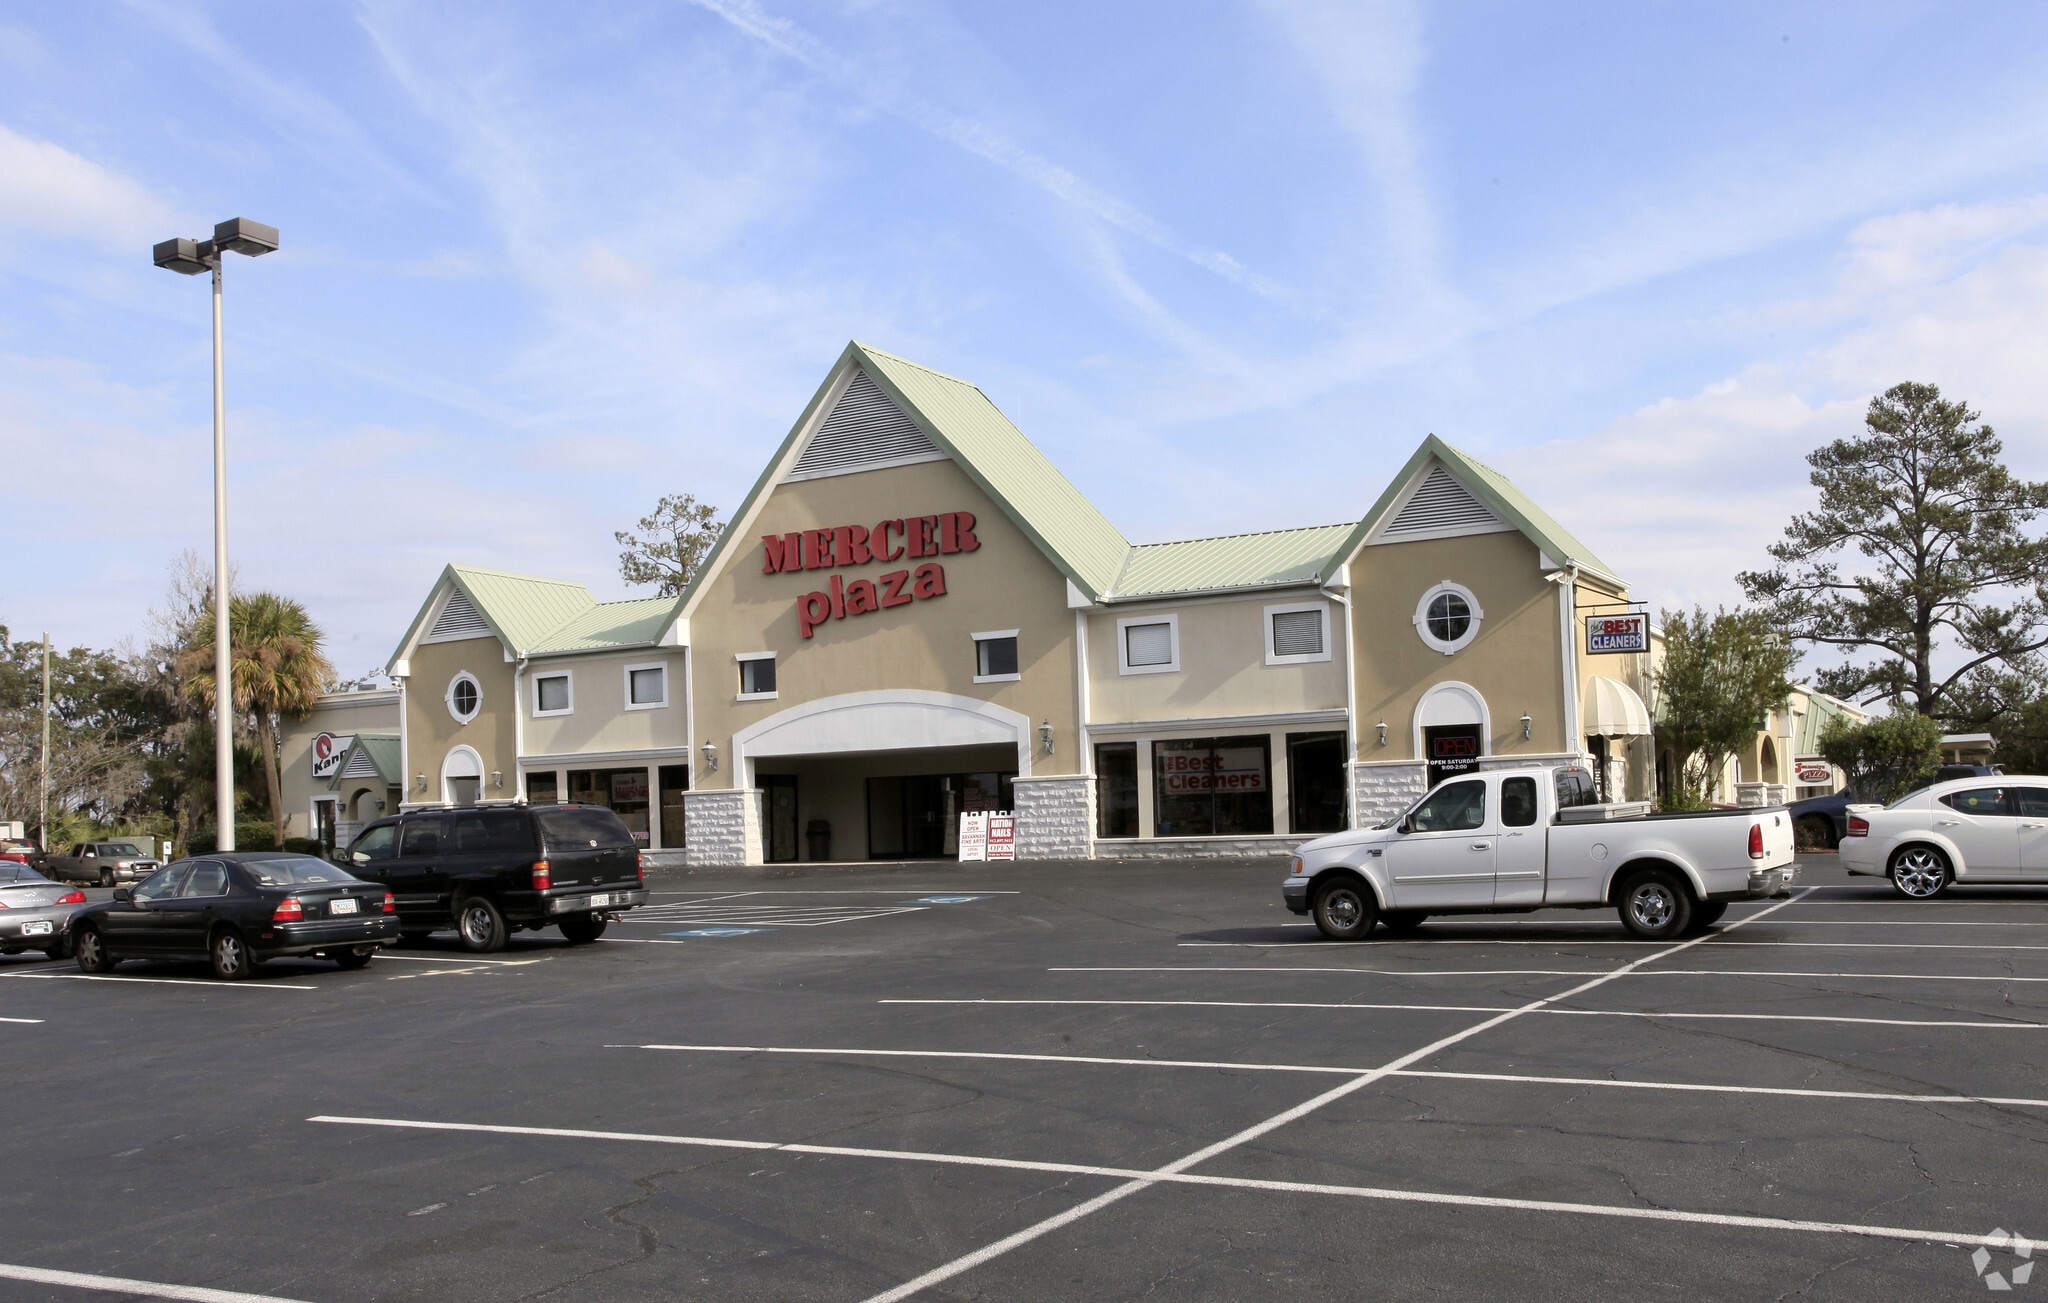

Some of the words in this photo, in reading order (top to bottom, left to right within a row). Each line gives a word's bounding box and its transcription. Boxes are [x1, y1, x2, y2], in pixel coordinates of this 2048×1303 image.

[761, 511, 982, 574] MERCER
[796, 562, 948, 639] plaza
[1604, 619, 1640, 634] BEST
[1592, 635, 1640, 650] CLEANERS
[1436, 738, 1475, 755] OPEN
[1175, 754, 1224, 771] Best
[1168, 773, 1260, 789] Cleaners
[991, 819, 1013, 828] NATION
[992, 829, 1011, 837] NAILS
